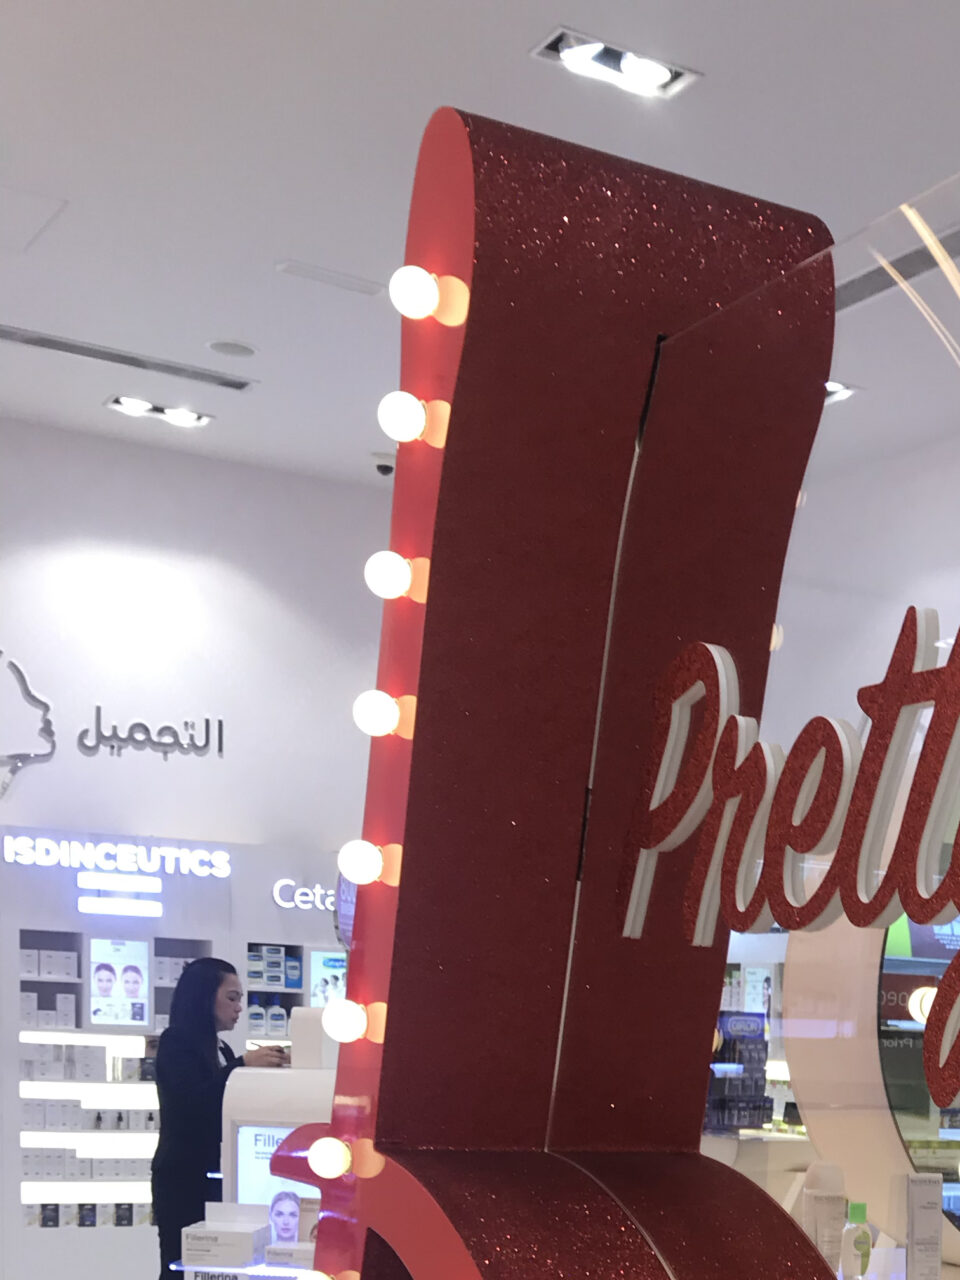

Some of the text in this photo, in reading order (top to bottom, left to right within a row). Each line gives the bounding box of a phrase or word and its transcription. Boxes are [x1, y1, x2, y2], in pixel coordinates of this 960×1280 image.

[77, 705, 224, 760] التجميل
[4, 835, 231, 878] ISDINCEUTICS
[273, 879, 335, 911] Ceta
[254, 1133, 282, 1148] Fille
